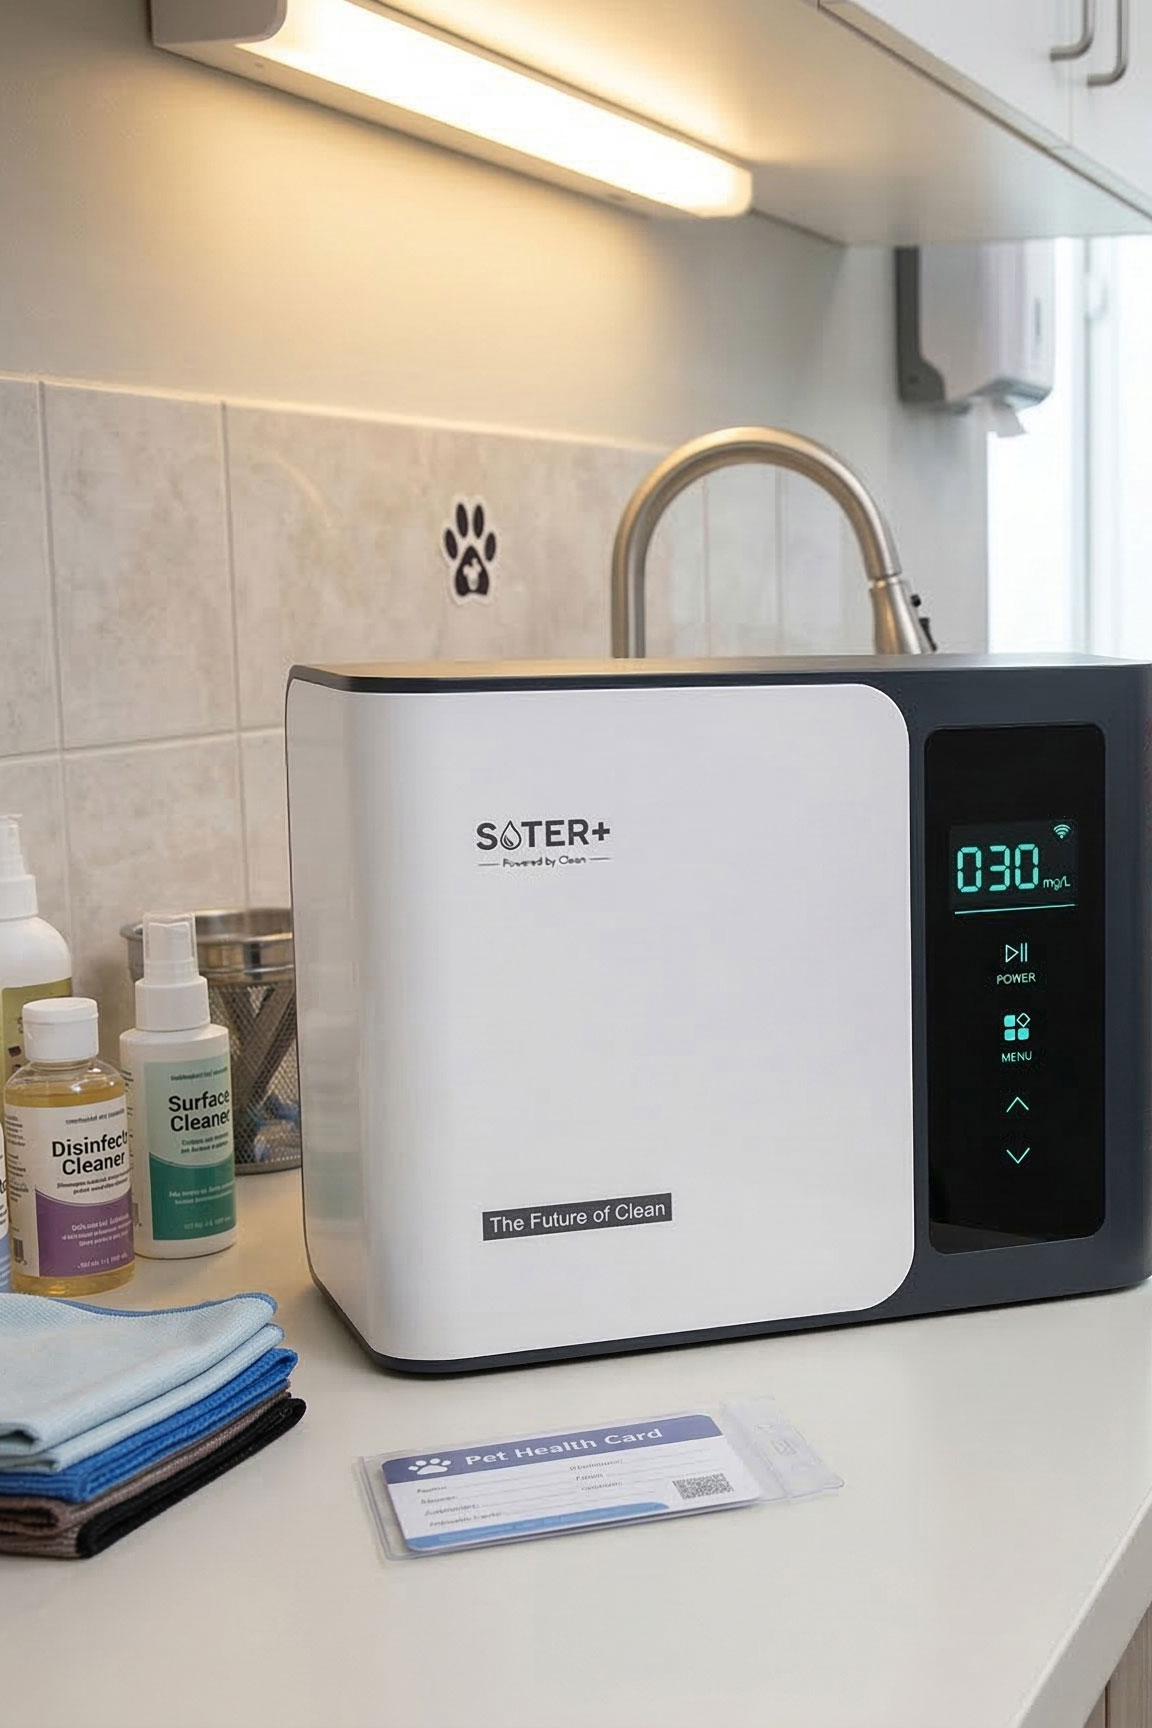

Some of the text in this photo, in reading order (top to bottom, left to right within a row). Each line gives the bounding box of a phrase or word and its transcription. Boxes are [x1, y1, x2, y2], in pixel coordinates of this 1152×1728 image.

[545, 856, 556, 868] by
[956, 843, 1071, 893] 030 mg/L
[996, 972, 1036, 985] POWER
[1001, 1051, 1033, 1063] MENU
[168, 1090, 230, 1113] Surface
[62, 1151, 126, 1175] Cleaner
[490, 1202, 666, 1233] The Future of Clean
[464, 1428, 663, 1466] Pet Health Card
